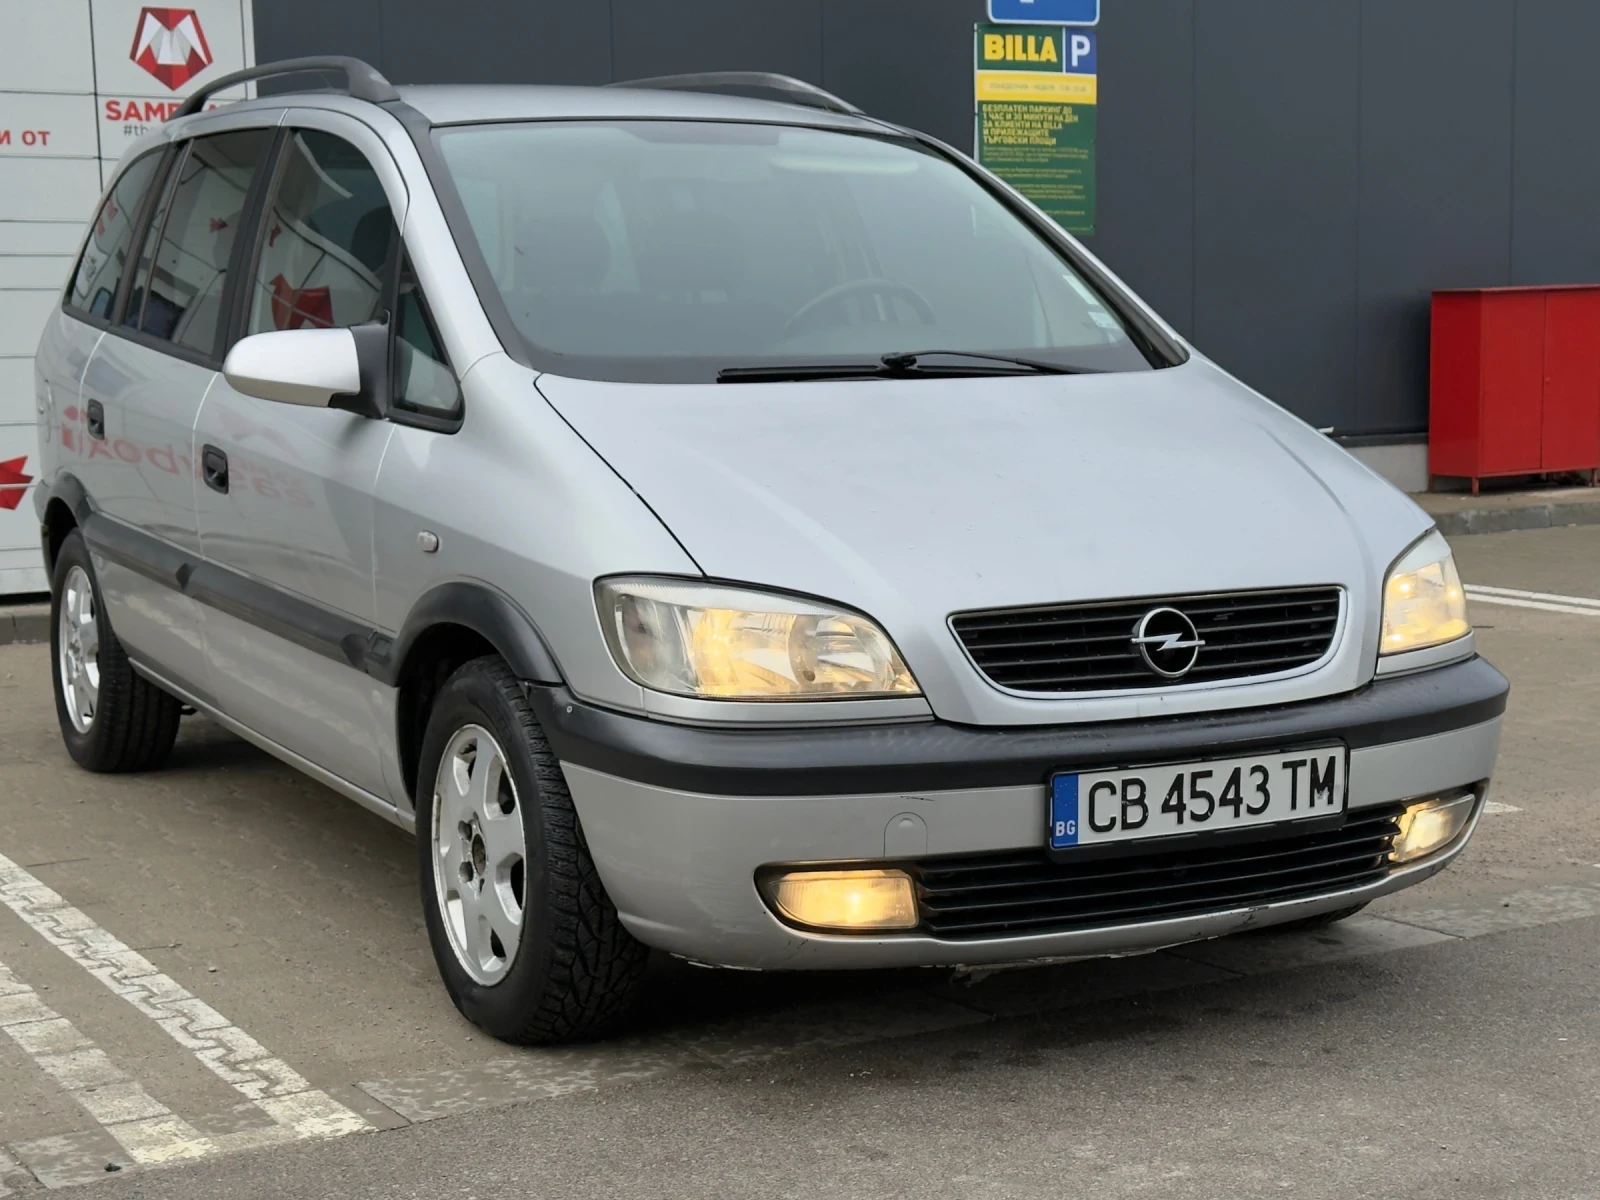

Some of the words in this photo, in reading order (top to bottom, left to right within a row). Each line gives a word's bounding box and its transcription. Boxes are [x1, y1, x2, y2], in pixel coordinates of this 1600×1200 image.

[984, 34, 1058, 62] BILLA
[1071, 34, 1091, 67] P
[982, 104, 1028, 113] БЕЗПЛАТЕН
[1029, 105, 1061, 113] ПАРКИНГ
[22, 130, 50, 146] ОТ
[1088, 778, 1149, 833] CB
[1161, 765, 1271, 824] 4543
[1282, 756, 1336, 811] TM
[1055, 821, 1076, 837] BG
